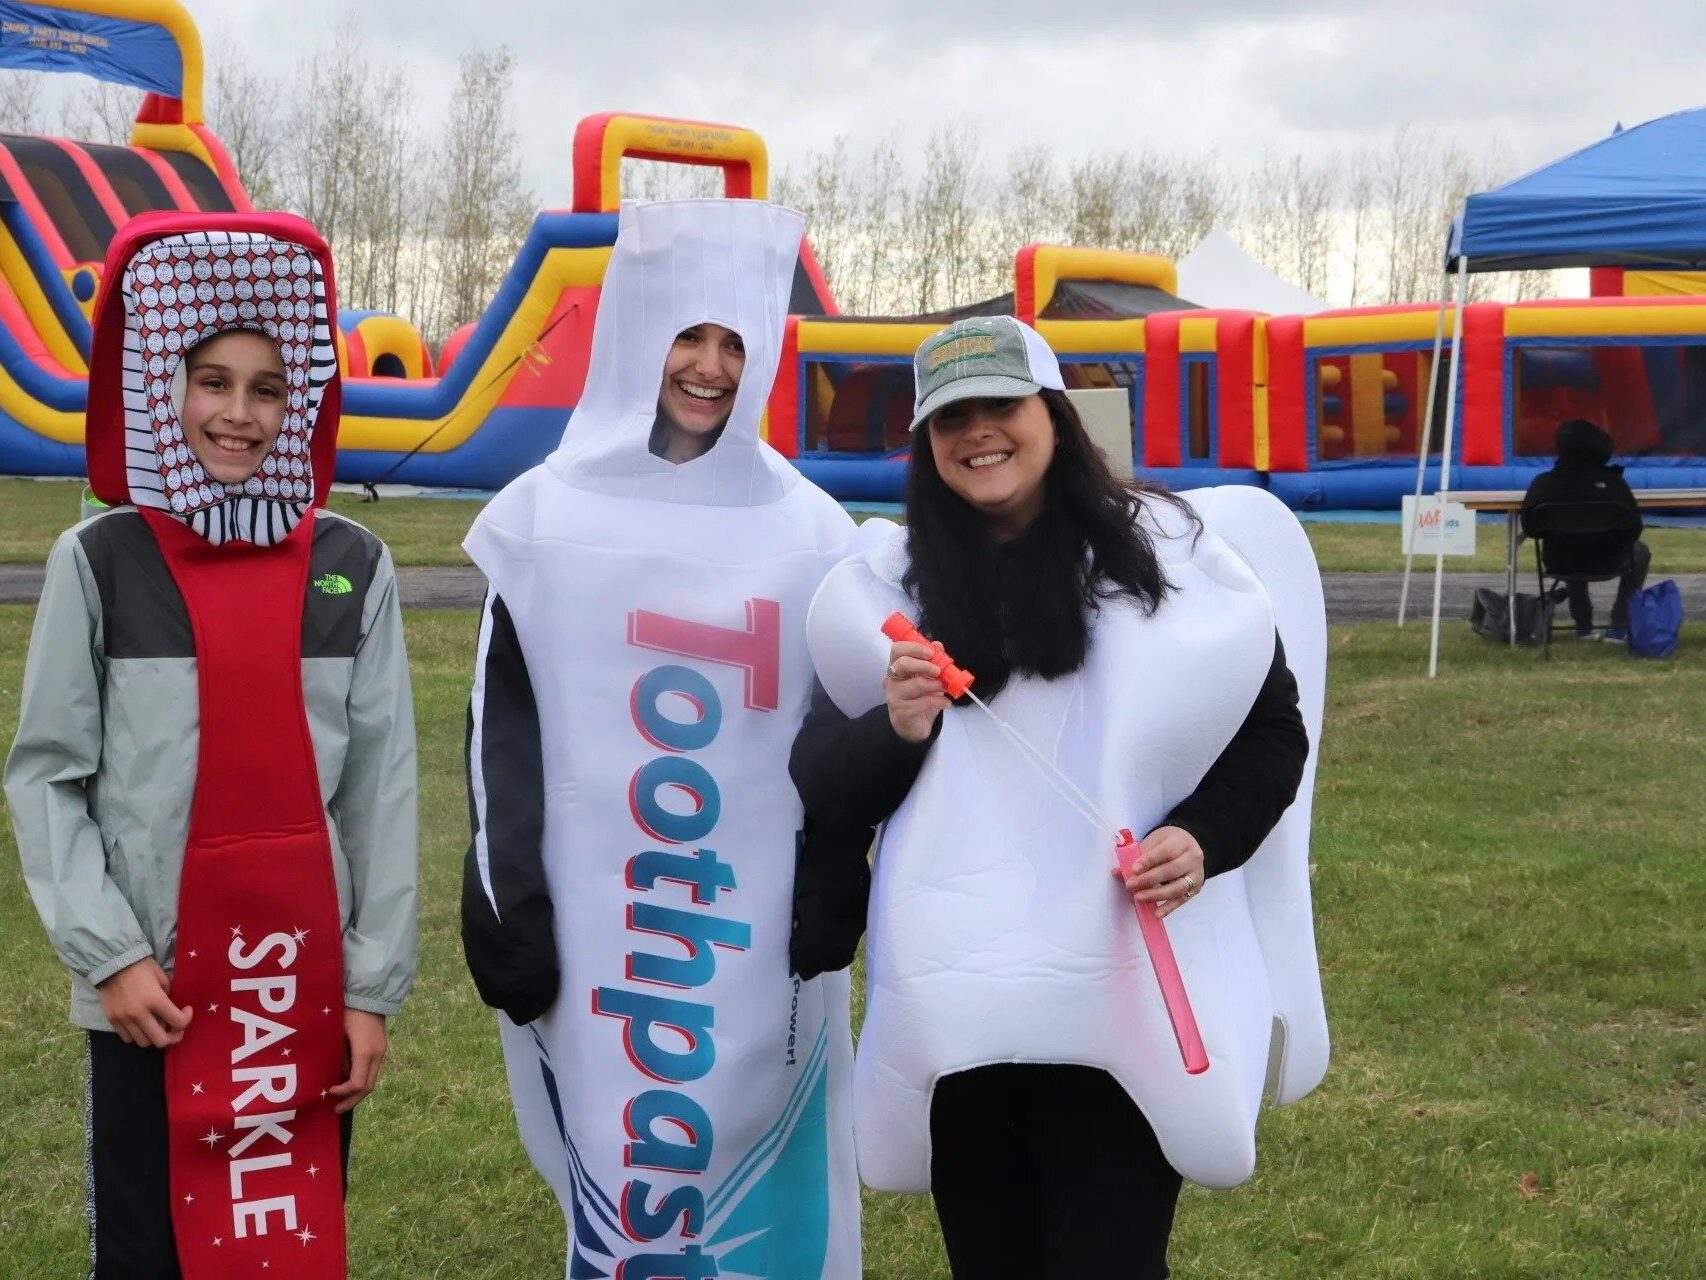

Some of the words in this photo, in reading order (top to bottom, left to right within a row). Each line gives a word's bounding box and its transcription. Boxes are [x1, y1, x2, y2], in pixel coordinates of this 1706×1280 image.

[324, 573, 338, 581] THE
[313, 579, 338, 587] NORTH
[227, 931, 298, 1239] SPARKLE
